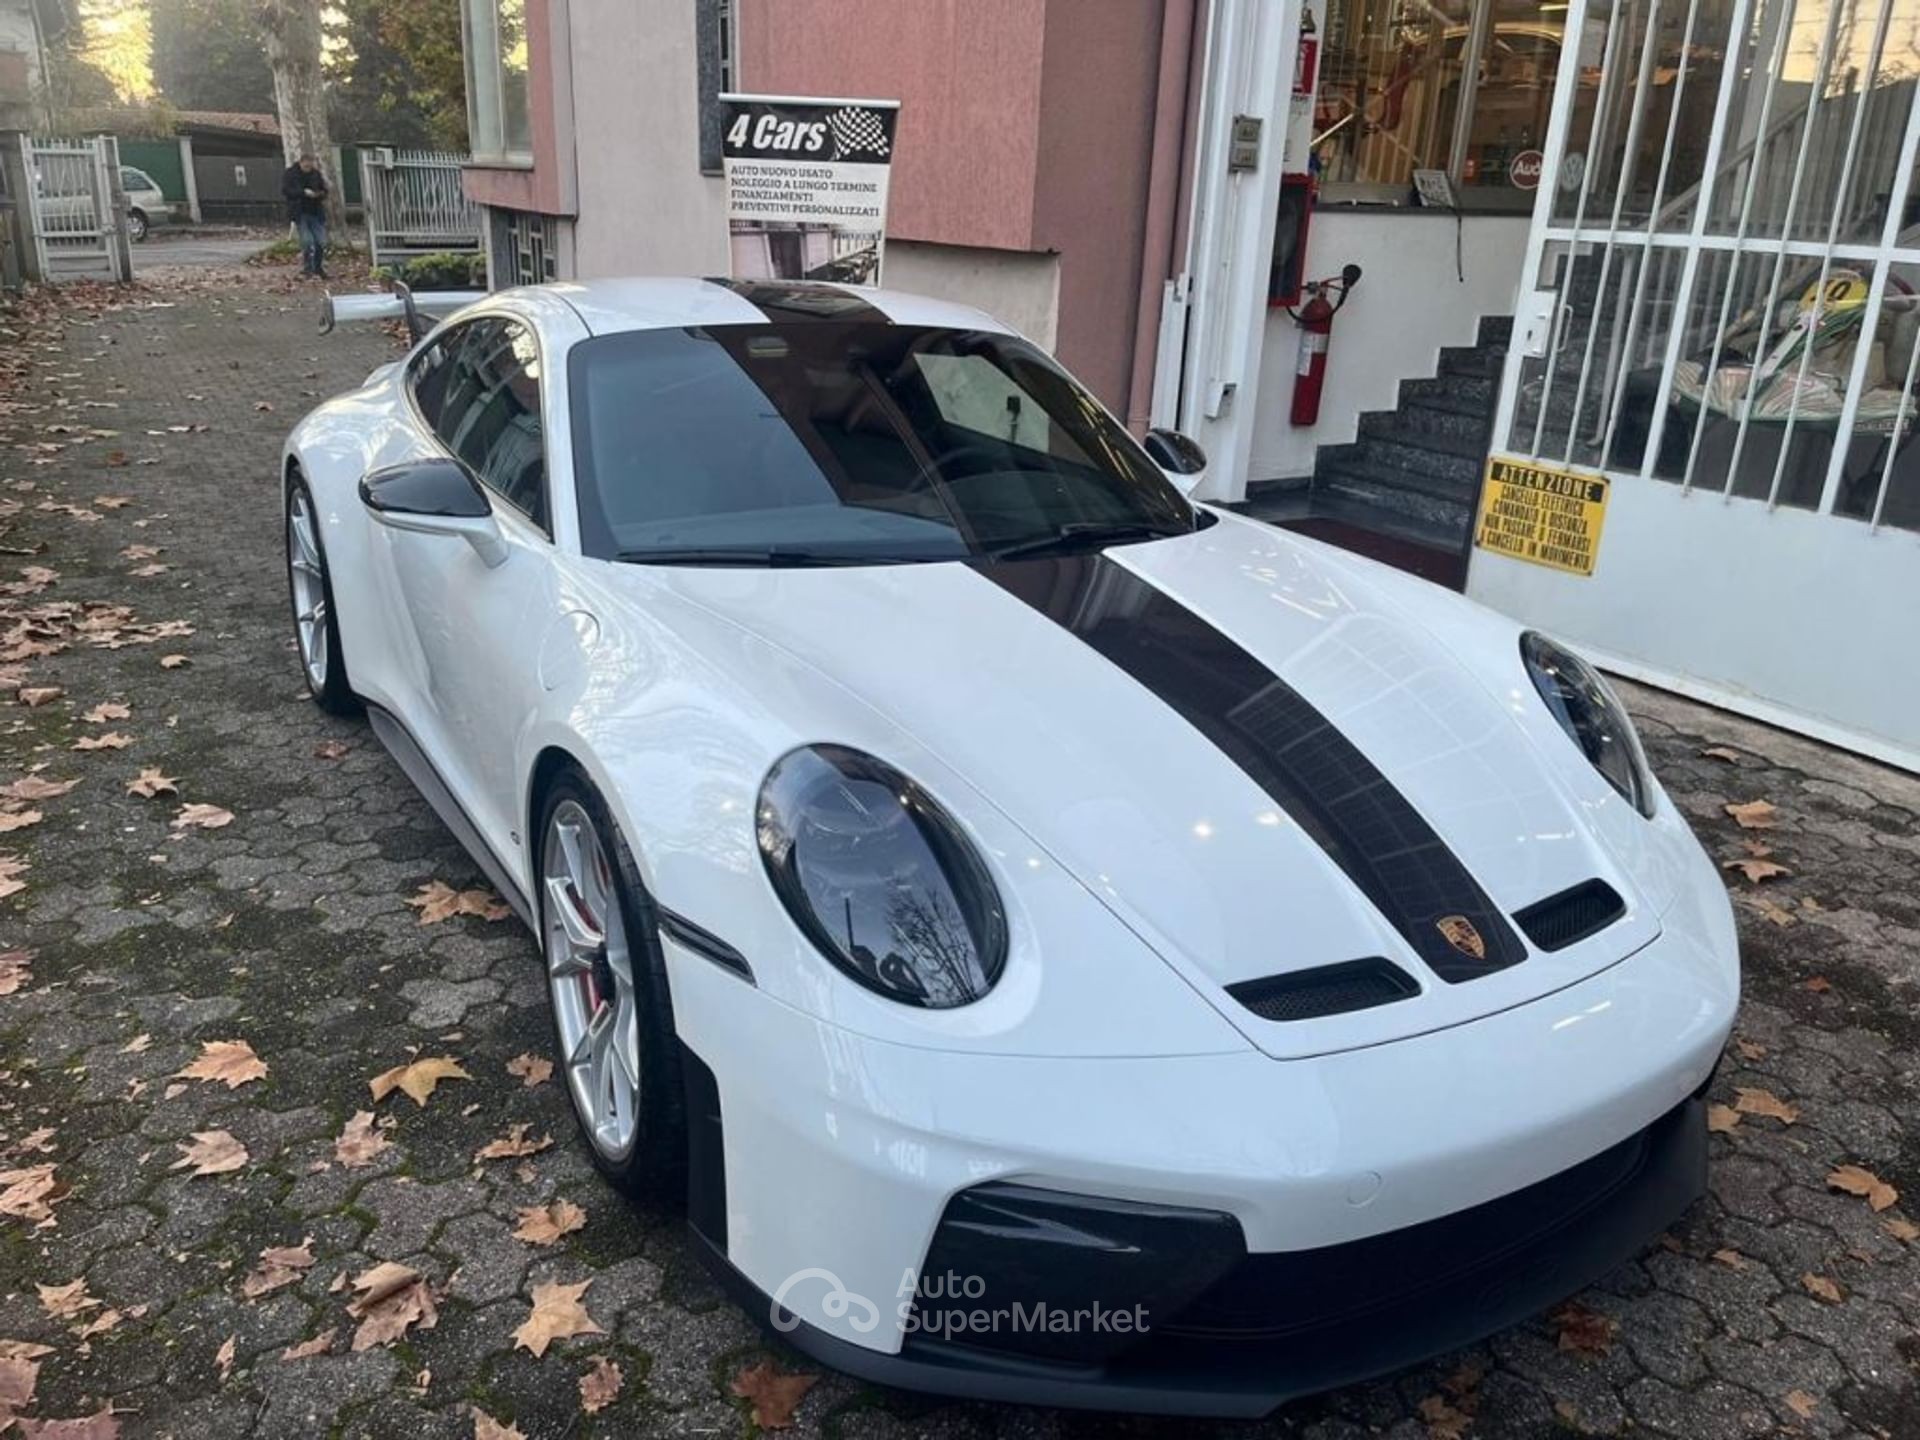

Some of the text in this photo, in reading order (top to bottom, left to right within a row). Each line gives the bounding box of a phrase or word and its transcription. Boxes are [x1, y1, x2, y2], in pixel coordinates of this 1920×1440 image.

[727, 114, 826, 151] 4 Cars
[731, 166, 833, 179] AUTO NUOVO USATO
[1512, 161, 1541, 176] Aud
[731, 178, 877, 192] NOLEGGIO A LUNGO TERMINE
[731, 190, 813, 201] FINANZIAMENTI
[731, 202, 879, 217] PREVENTIVI PERSONALIZZATI
[1500, 464, 1593, 500] ATTENZIONE
[1501, 483, 1538, 506] CANCELLO
